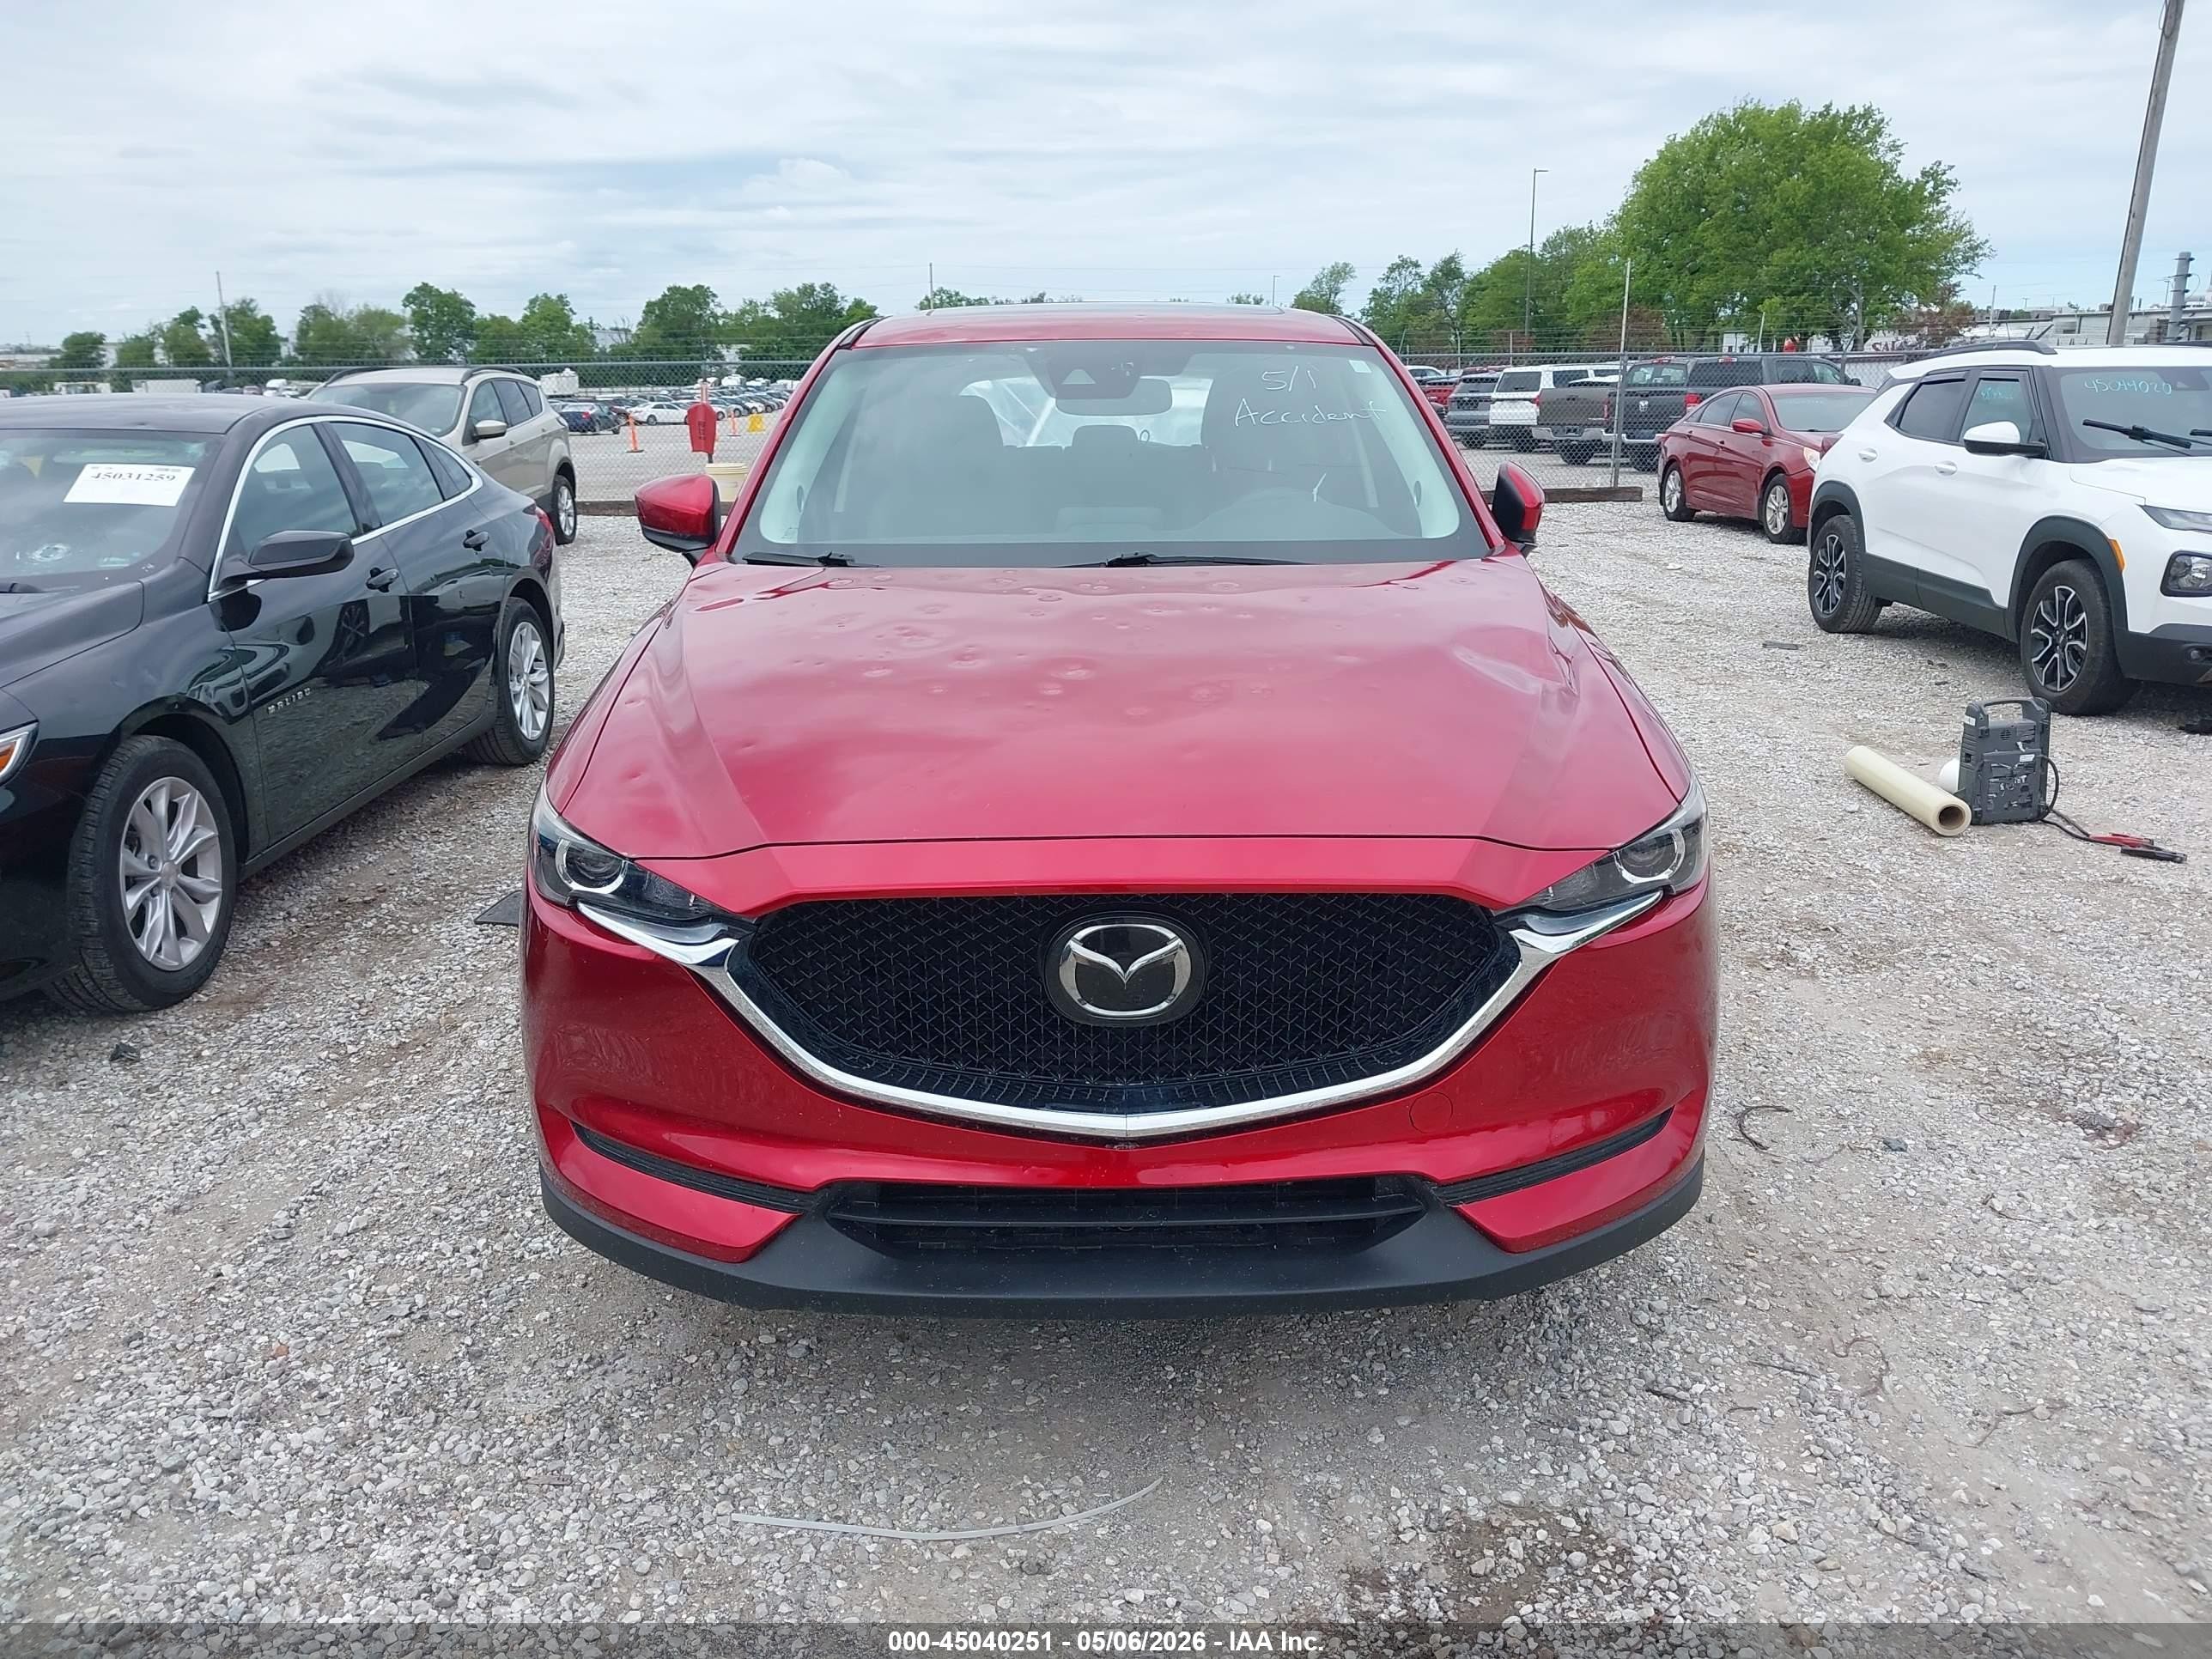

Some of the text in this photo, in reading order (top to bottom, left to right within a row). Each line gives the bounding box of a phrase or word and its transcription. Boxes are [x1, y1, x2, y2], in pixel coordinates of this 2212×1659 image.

[1261, 366, 1316, 392] 5/1
[1235, 398, 1386, 427] Accident
[90, 472, 176, 482] 45031259
[267, 687, 311, 715] MALIBU
